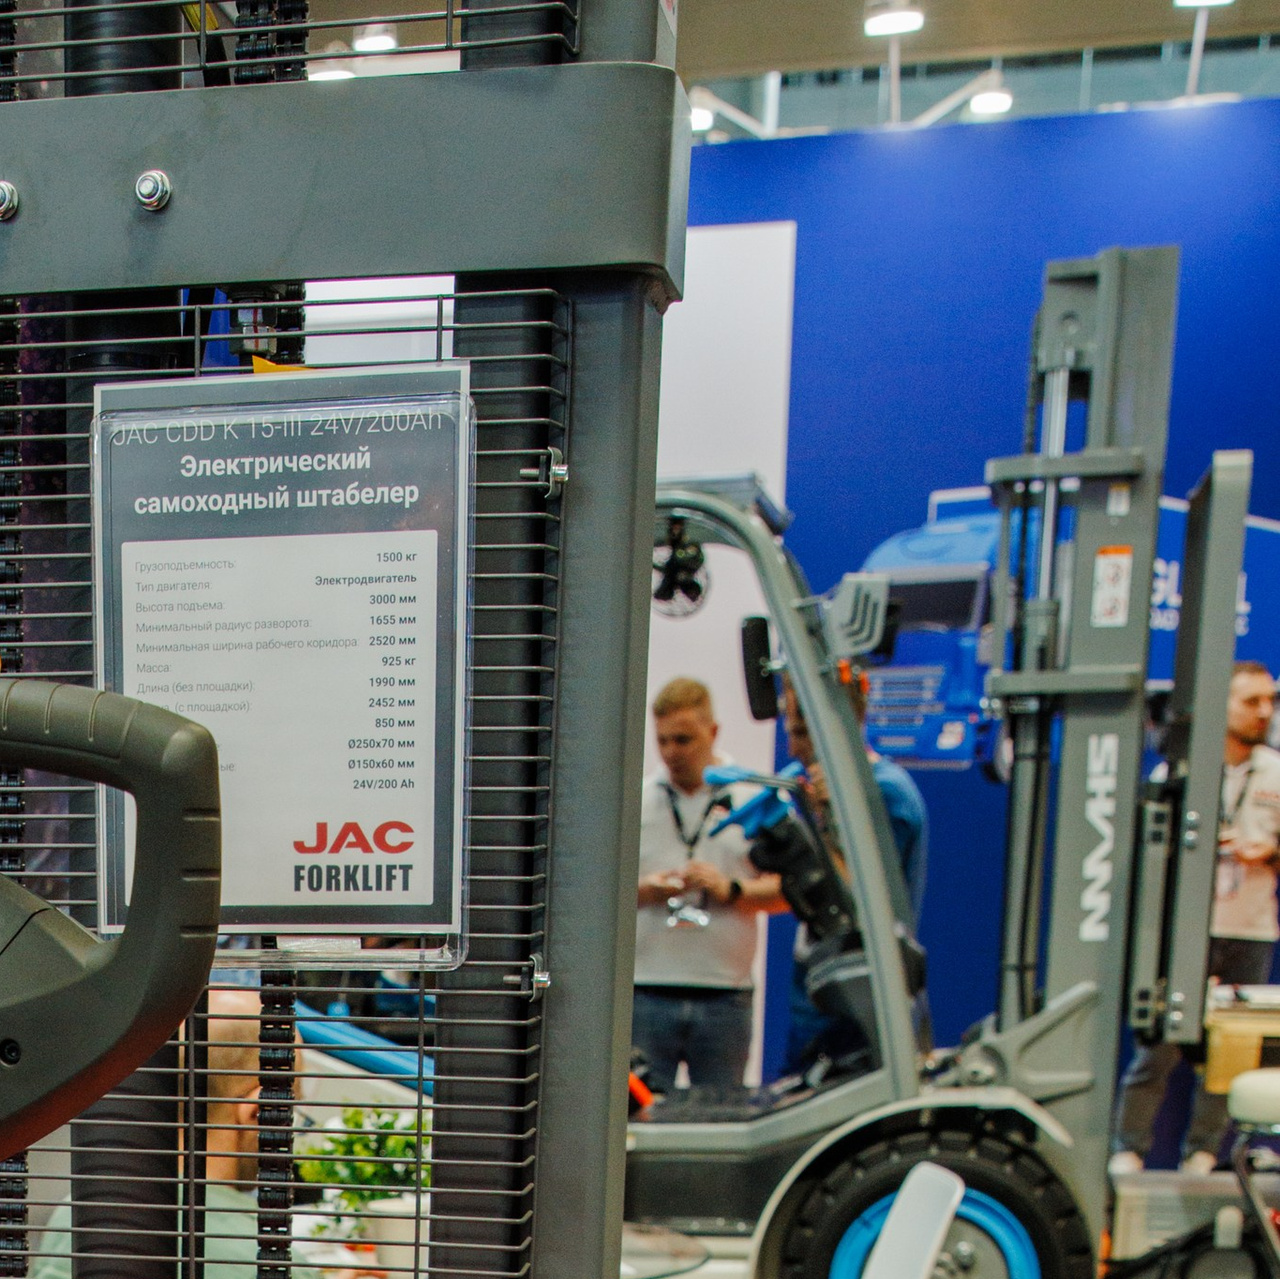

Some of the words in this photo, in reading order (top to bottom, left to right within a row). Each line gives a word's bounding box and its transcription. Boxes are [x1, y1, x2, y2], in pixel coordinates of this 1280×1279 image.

[113, 422, 158, 446] JAC
[166, 419, 215, 443] CDD
[223, 418, 239, 440] K
[310, 407, 441, 436] 24V/200Ah
[180, 445, 371, 480] Электрический
[134, 485, 290, 515] самоходный
[297, 482, 420, 508] штабелер
[376, 551, 403, 563] 1500
[406, 552, 417, 562] кг
[314, 573, 418, 587] Электродвигатель
[135, 581, 154, 593] Тип
[369, 594, 396, 605] 3000
[399, 595, 417, 604] мм
[135, 602, 174, 613] Высота
[370, 614, 396, 625] 1655
[399, 616, 417, 625] мм
[136, 621, 213, 633] Минимальный
[215, 620, 252, 632] радиус
[136, 642, 210, 653] Минимальная
[212, 641, 253, 653] ширина
[256, 638, 304, 651] рабочего
[369, 635, 396, 646] 2520
[398, 637, 417, 646] мм
[381, 656, 402, 667] 925
[404, 657, 417, 666] кг
[136, 683, 170, 695] Длина
[172, 681, 194, 695] (без
[369, 677, 396, 688] 1990
[398, 679, 416, 687] мм
[368, 697, 395, 708] 2452
[398, 699, 416, 707] мм
[375, 718, 395, 729] 850
[397, 720, 416, 728] мм
[397, 740, 415, 749] мм
[397, 760, 415, 769] мм
[352, 779, 398, 790] 24V/200
[400, 778, 415, 789] Ah
[292, 820, 415, 855] JAC
[293, 864, 413, 892] FORKLIFT
